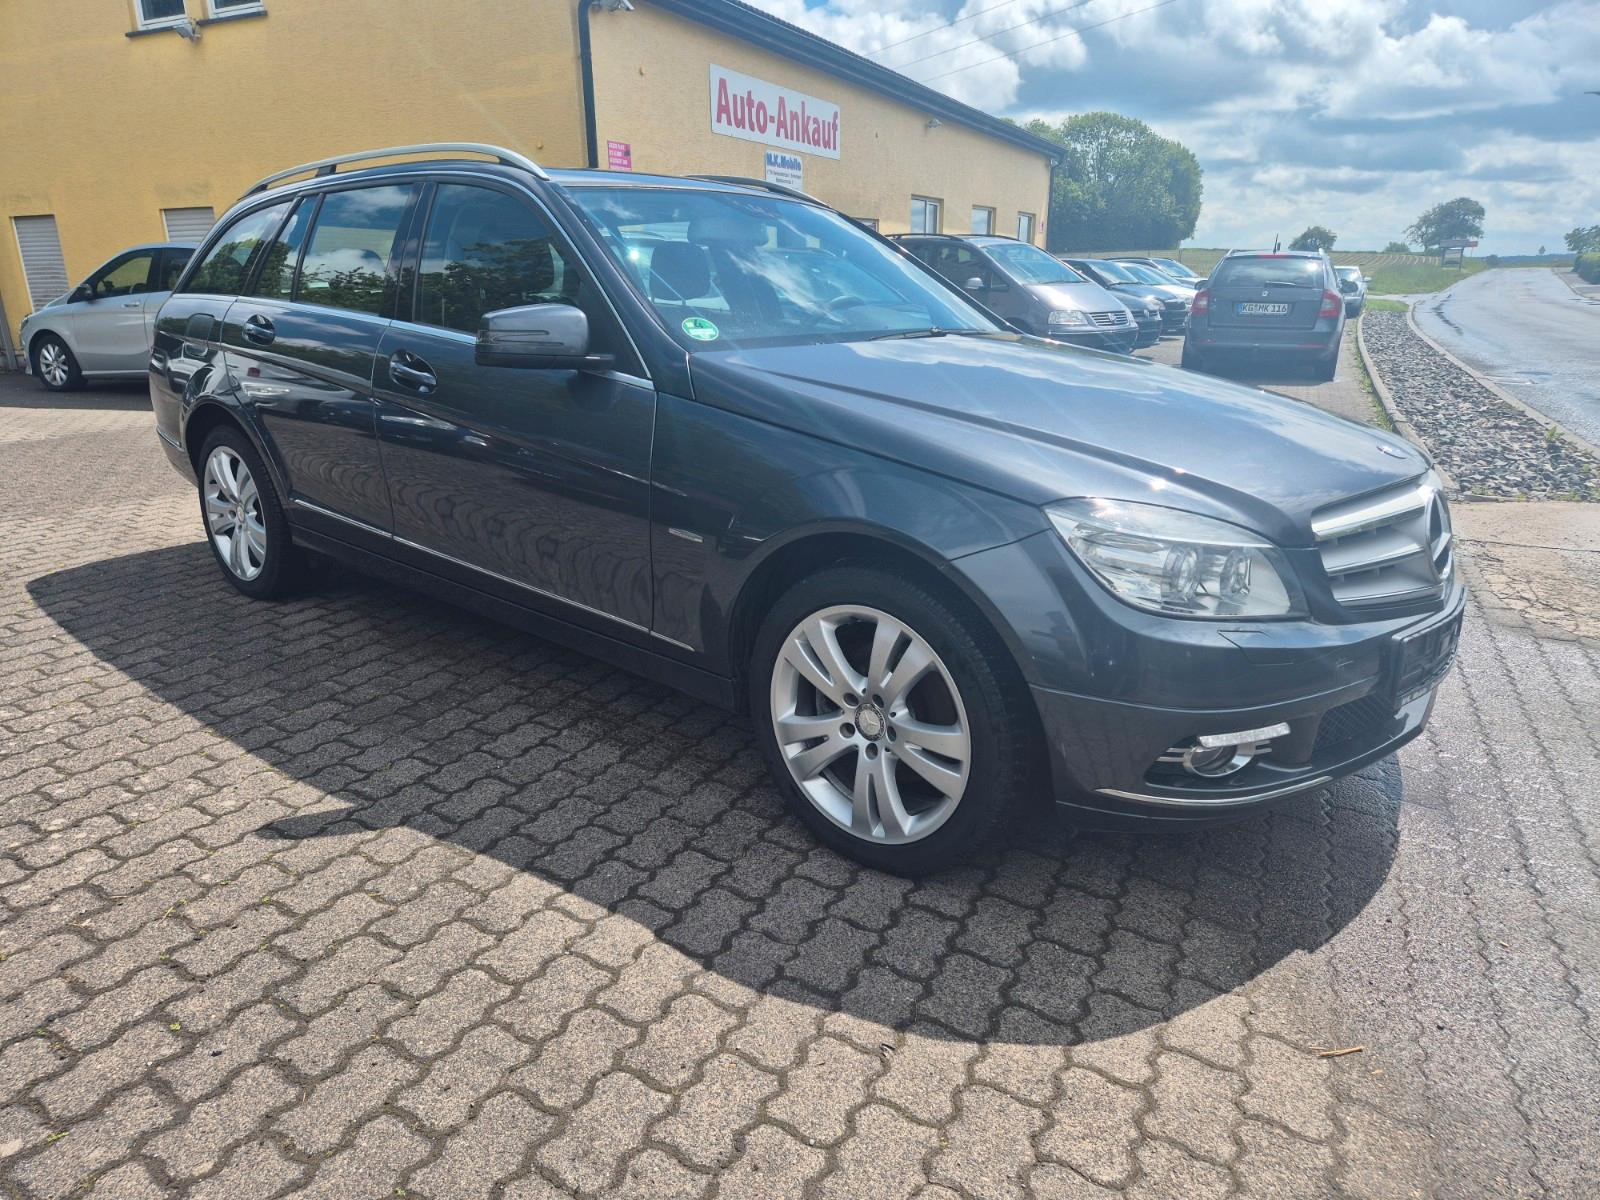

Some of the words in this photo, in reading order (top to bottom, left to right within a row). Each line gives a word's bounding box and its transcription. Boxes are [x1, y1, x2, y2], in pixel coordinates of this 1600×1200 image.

[716, 77, 839, 151] Auto-Ankauf
[1242, 303, 1254, 312] KG
[1271, 304, 1287, 313] 116
